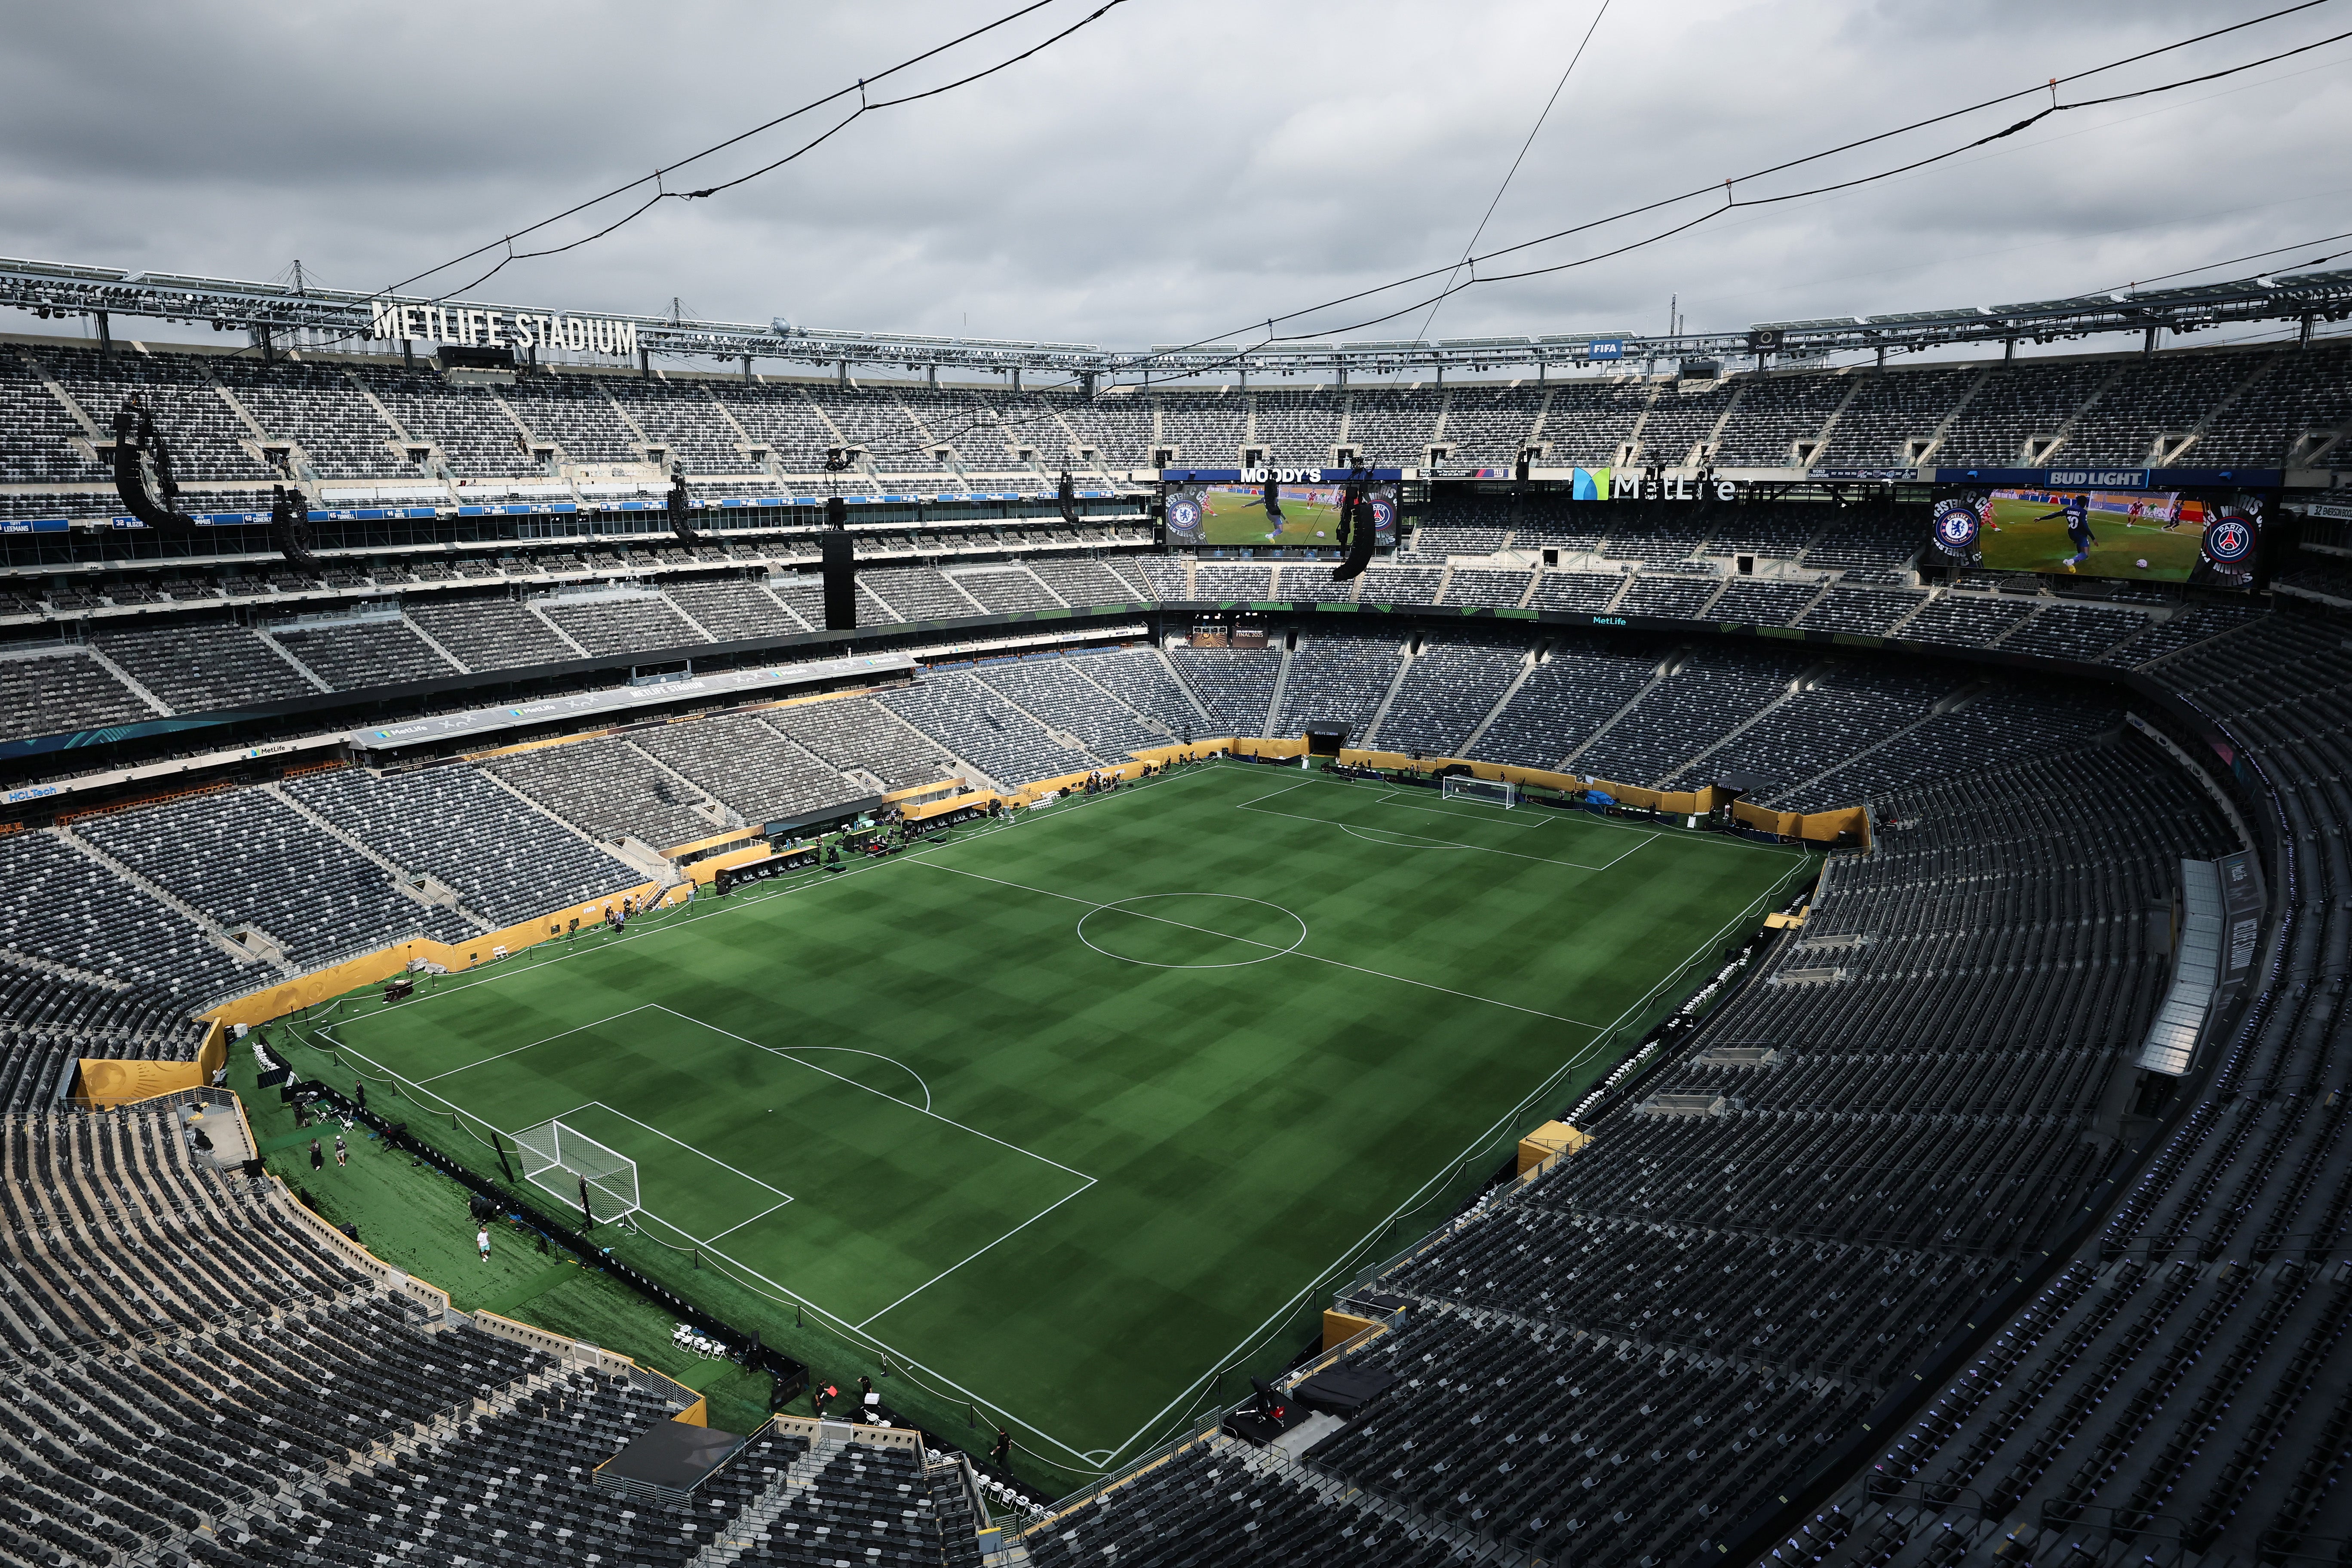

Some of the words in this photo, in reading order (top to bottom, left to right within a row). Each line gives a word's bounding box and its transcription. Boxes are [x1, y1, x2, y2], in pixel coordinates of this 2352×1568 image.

[372, 301, 506, 346] METLIFE
[516, 313, 638, 354] STADIUM
[1594, 344, 1617, 353] FIFA
[2050, 472, 2087, 485] BUD
[2088, 472, 2142, 485] LIGHT
[2323, 507, 2342, 517] EMERSON
[2067, 516, 2079, 529] 10
[2219, 524, 2244, 534] PARIS
[1593, 616, 1626, 625] MetLife
[629, 687, 669, 698] METLIFE
[666, 681, 706, 692] STADIUM
[522, 705, 556, 714] MetLife
[390, 725, 428, 736] MetLife
[261, 746, 286, 754] MetLife
[9, 786, 57, 802] HCLTech
[583, 905, 597, 914] FIFA
[2233, 917, 2257, 944] METLIFE
[2231, 941, 2256, 970] STADIUM
